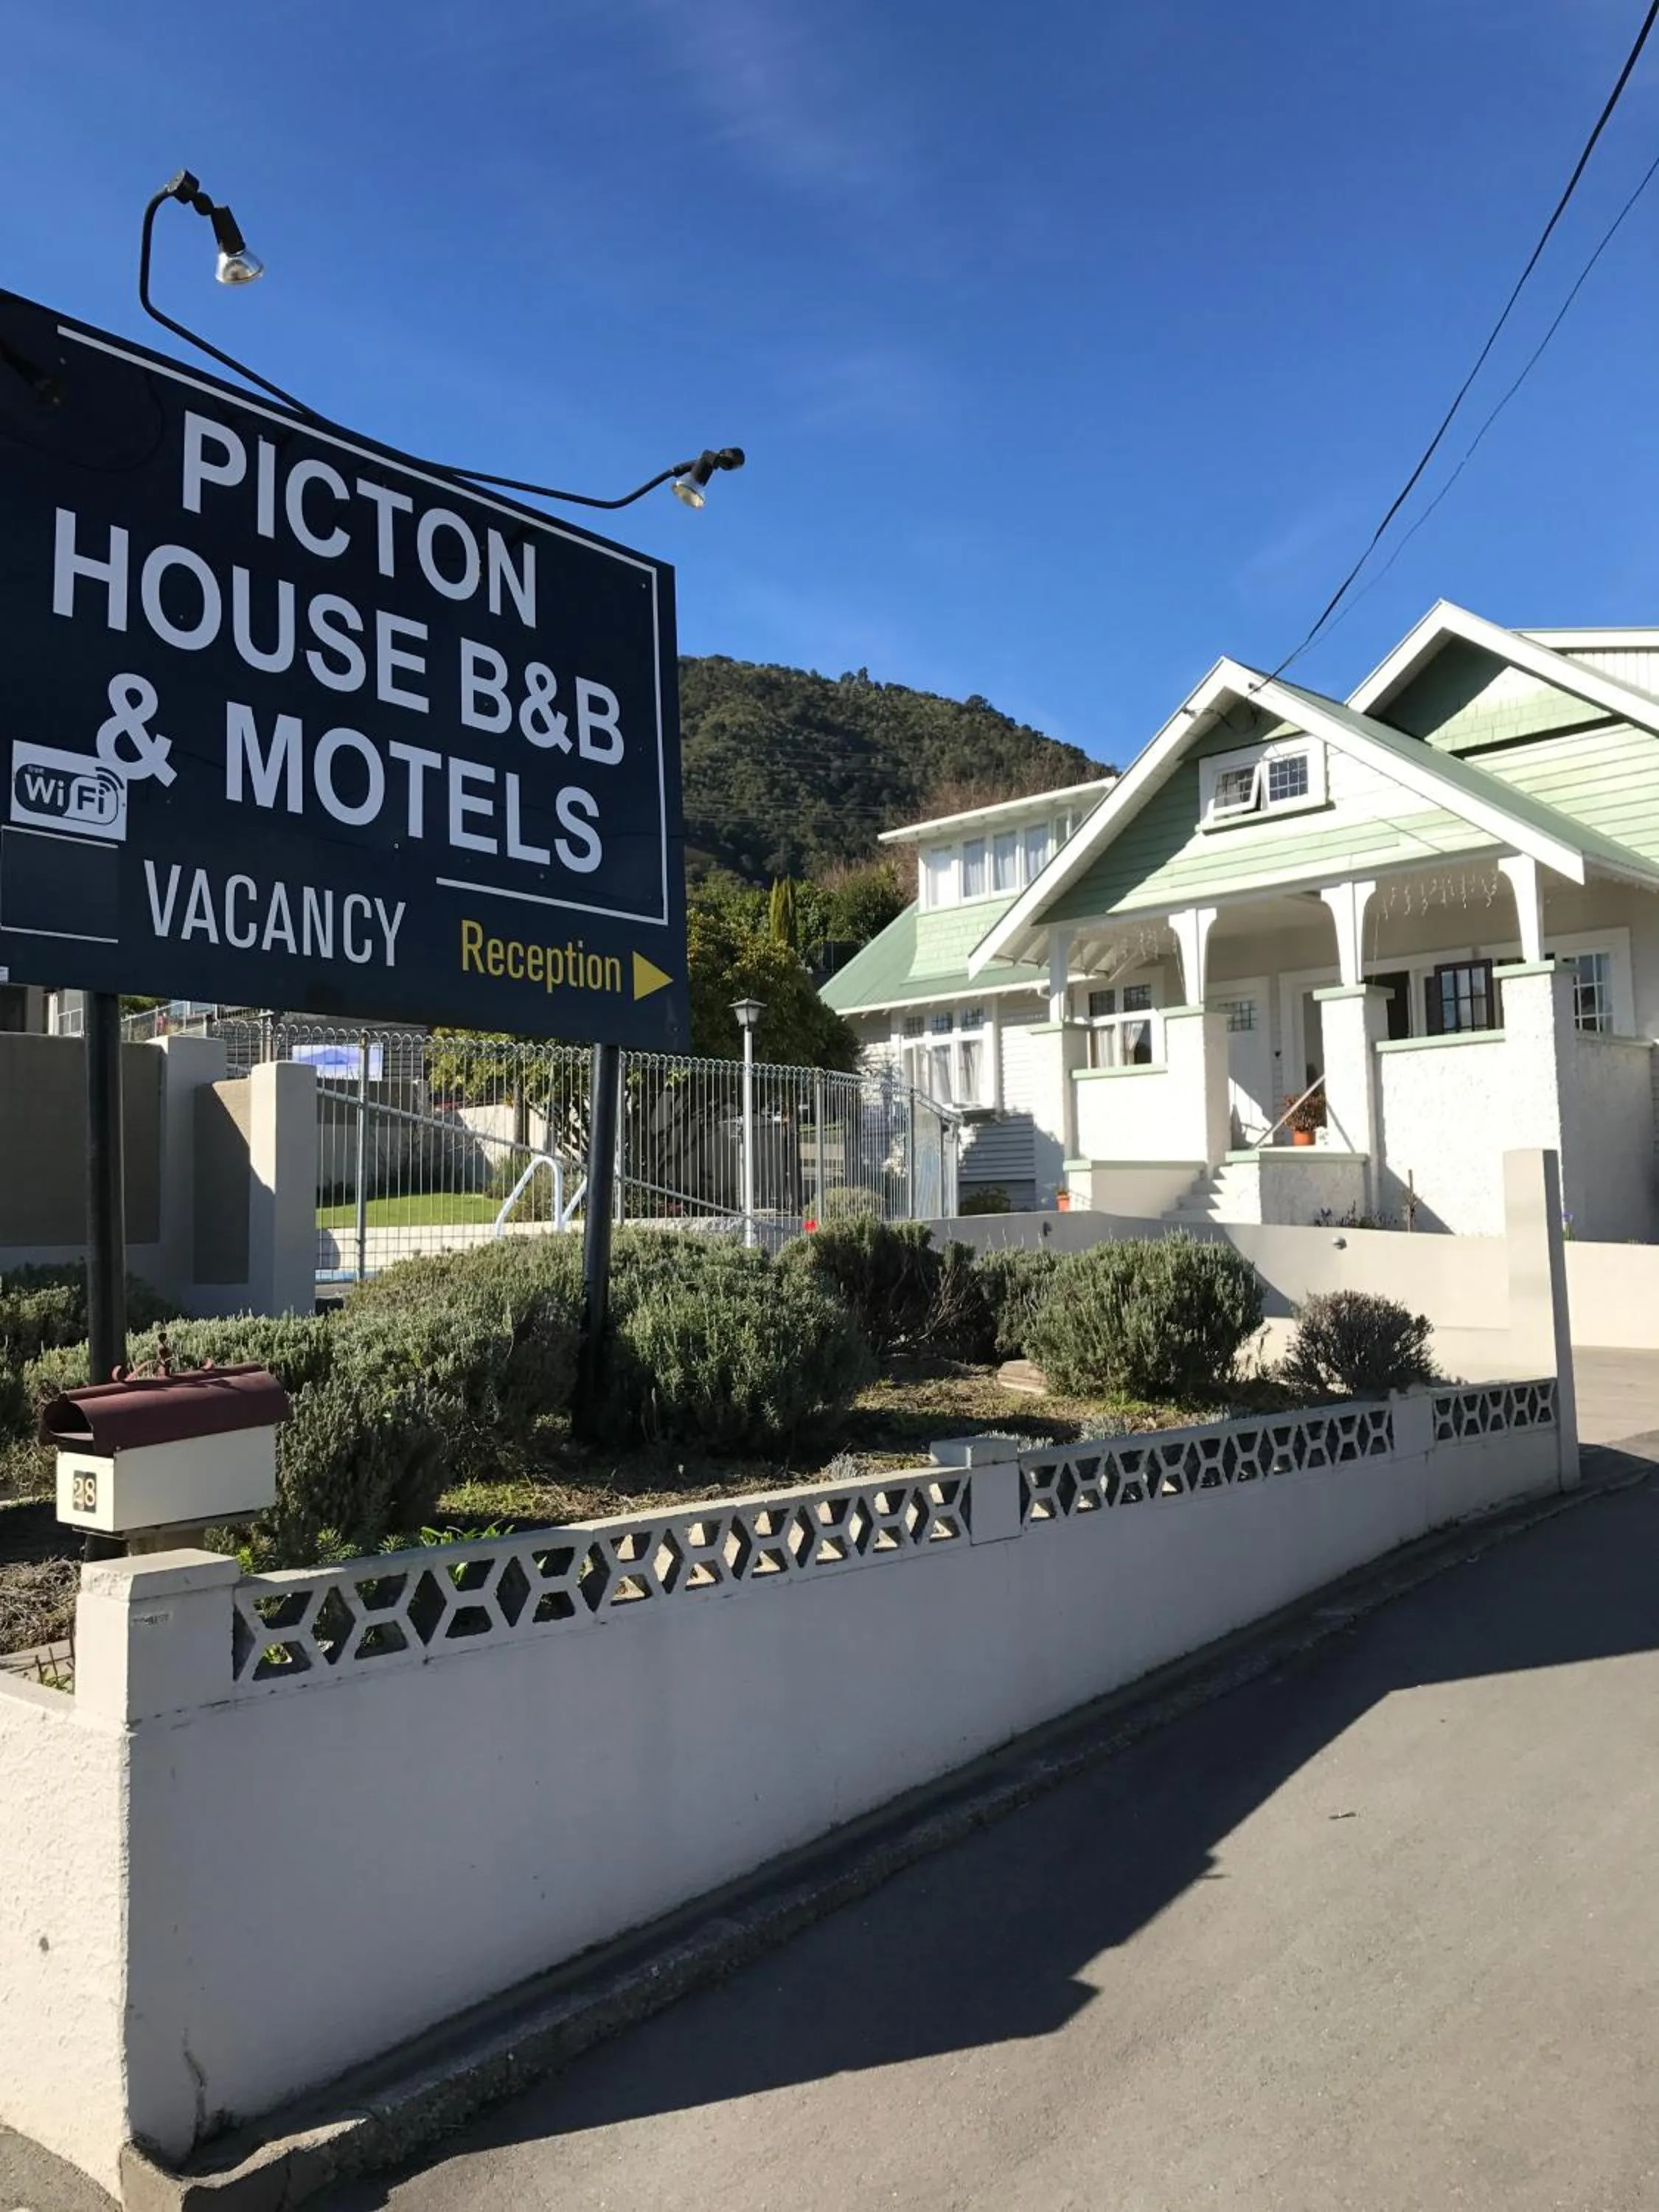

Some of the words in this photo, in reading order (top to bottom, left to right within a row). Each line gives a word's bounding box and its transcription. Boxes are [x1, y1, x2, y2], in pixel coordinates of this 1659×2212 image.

[183, 411, 537, 628] PICTON
[53, 507, 429, 713] HOUSE
[461, 637, 625, 765] B&B
[96, 672, 178, 787] &
[226, 701, 602, 872] MOTELS
[144, 860, 406, 967] VACANCY
[462, 919, 621, 992] Reception
[73, 1477, 95, 1506] 28
